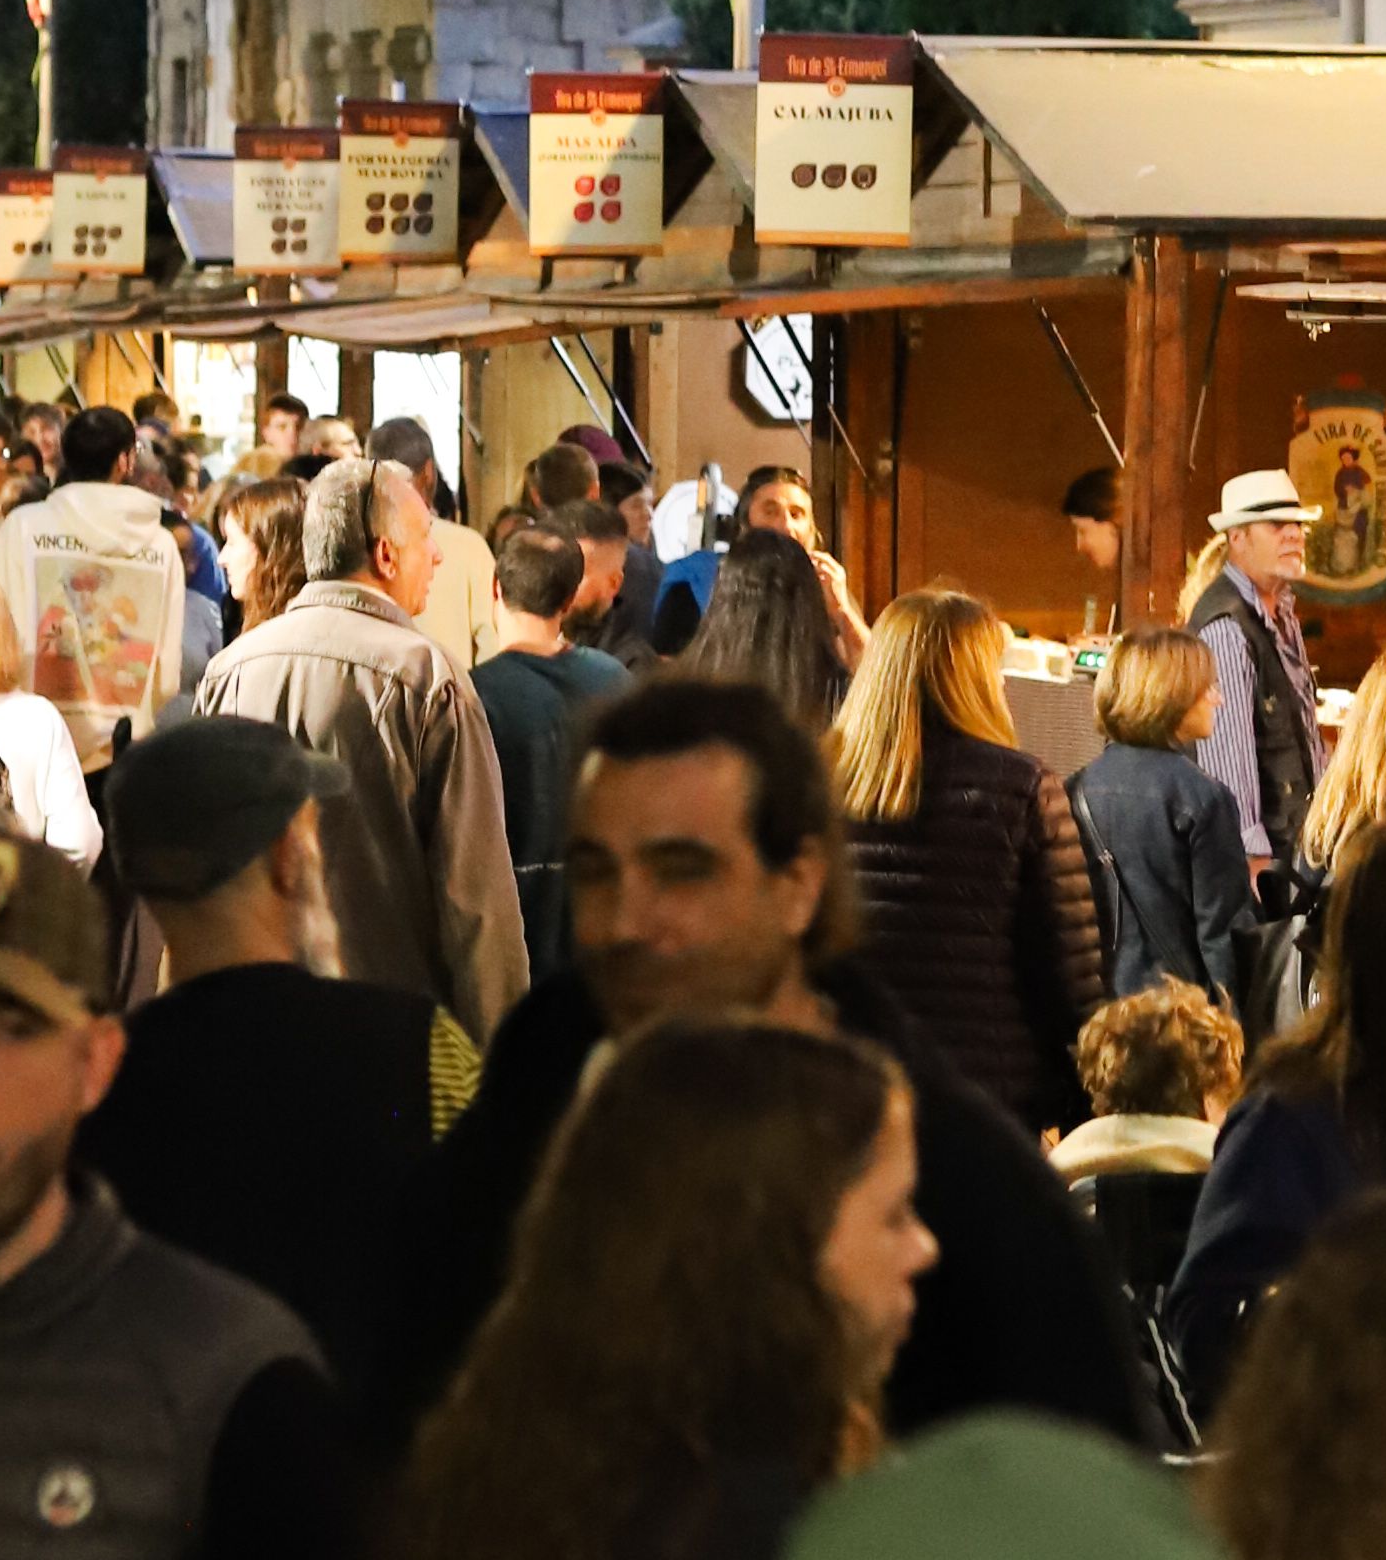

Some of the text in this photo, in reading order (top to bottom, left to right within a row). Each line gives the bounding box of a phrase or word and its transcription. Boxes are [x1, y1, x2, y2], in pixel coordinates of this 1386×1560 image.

[788, 54, 806, 76] fira
[809, 57, 821, 76] de
[774, 105, 893, 122] CAL MAJUBA
[557, 135, 638, 148] MAS ALBA
[357, 168, 387, 179] MAS
